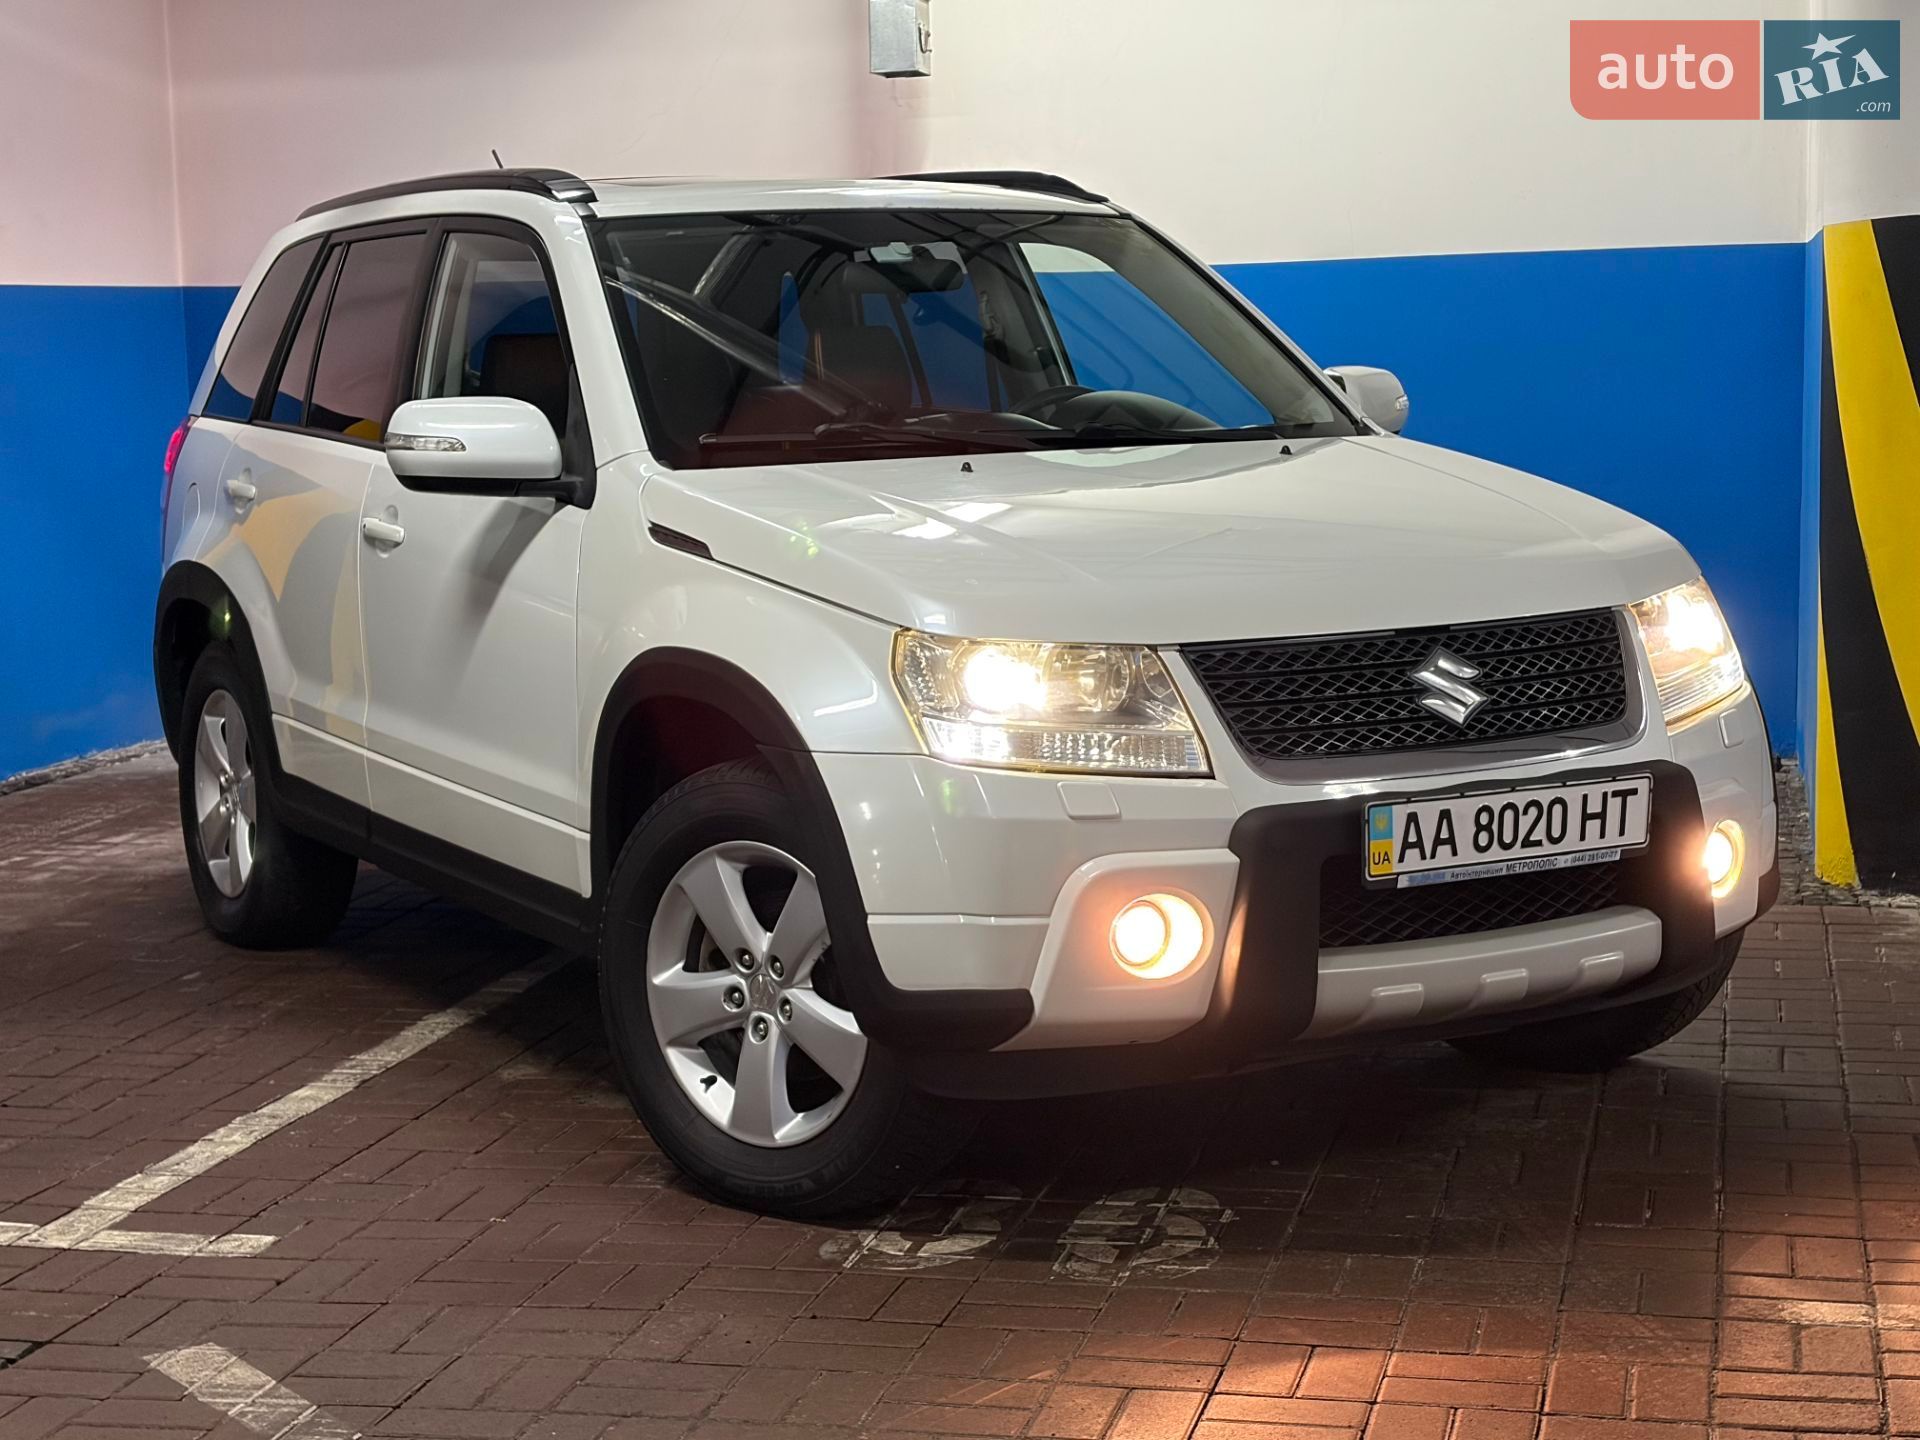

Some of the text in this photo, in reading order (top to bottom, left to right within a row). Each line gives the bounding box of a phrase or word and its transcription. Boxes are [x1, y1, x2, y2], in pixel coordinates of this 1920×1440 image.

[1398, 787, 1639, 863] AA 8020 HT
[1372, 850, 1391, 866] UA
